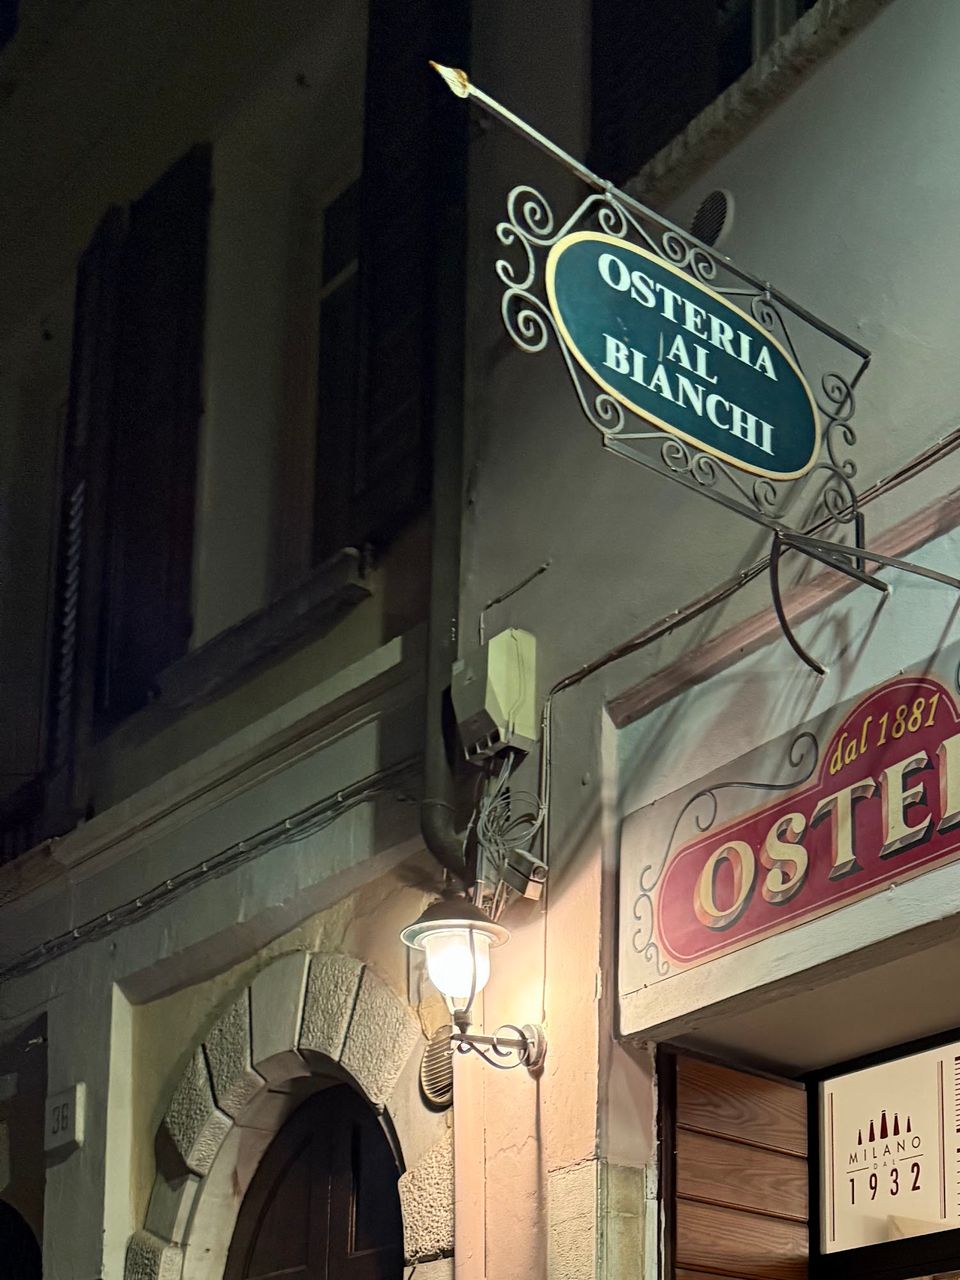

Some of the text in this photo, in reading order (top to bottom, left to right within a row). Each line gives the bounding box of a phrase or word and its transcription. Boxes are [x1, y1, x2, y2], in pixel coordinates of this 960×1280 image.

[597, 253, 779, 382] OSTERIA
[666, 334, 718, 384] AL
[602, 333, 775, 456] BIANCHI
[829, 692, 941, 775] dal 1881
[849, 1136, 921, 1165] MILANO
[873, 1158, 896, 1170] DAL
[849, 1162, 921, 1205] 1932
